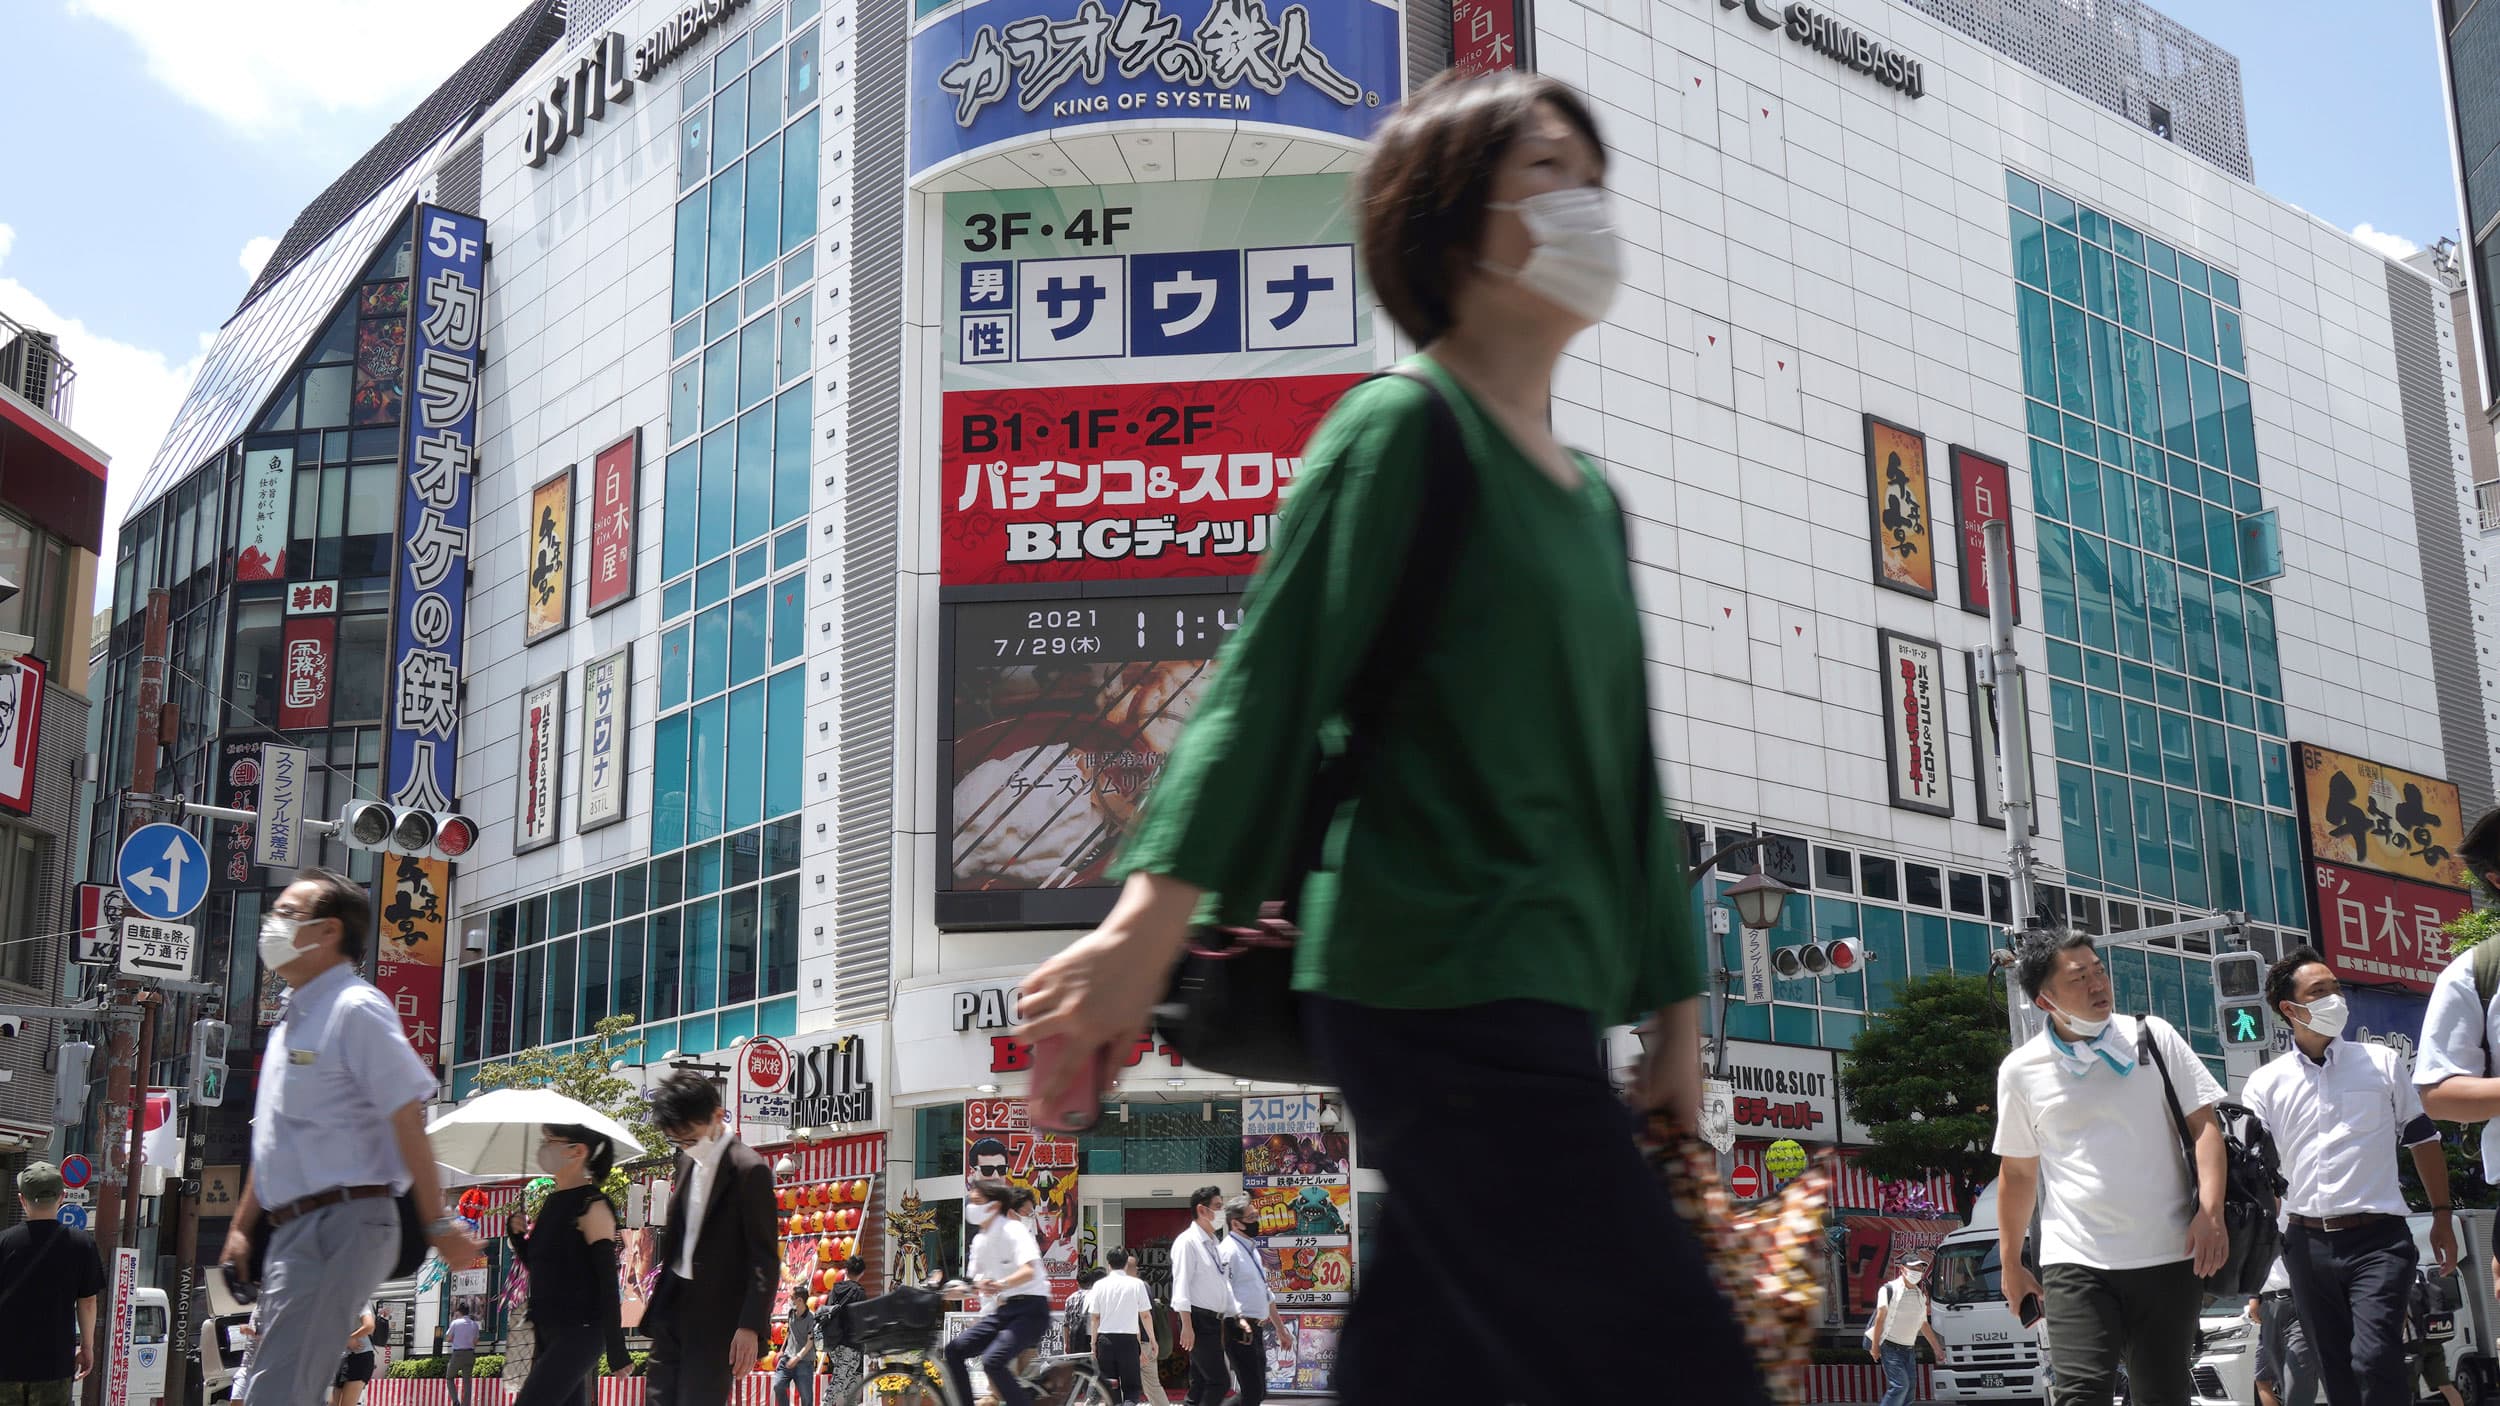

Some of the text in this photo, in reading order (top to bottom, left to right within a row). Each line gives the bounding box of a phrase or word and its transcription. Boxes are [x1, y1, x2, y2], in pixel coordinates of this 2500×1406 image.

[938, 0, 1363, 127] カラオケの鉄人
[1785, 2, 1925, 99] SHIMBASHI
[1053, 91, 1251, 117] KING OF SYSTEM
[428, 216, 477, 263] 5F
[963, 207, 1133, 252] 3F・4F
[969, 268, 1006, 356] 男性
[1036, 262, 1334, 342] サウナ
[601, 463, 629, 582] 白木屋
[393, 269, 481, 813] カラオケの鉄人
[292, 585, 332, 610] 羊肉
[1028, 610, 1098, 629] 2021
[593, 685, 612, 788] サウナ
[2304, 749, 2322, 771] 6F
[2316, 867, 2335, 889] 6F
[127, 924, 190, 945] 自転車を除く
[2336, 879, 2450, 966] 白木屋
[127, 943, 188, 961] 一方通行
[378, 965, 397, 977] 6F
[751, 1056, 782, 1076] 消火栓
[759, 1106, 789, 1117] ホテル
[968, 1101, 1009, 1130] 8.2
[1248, 1096, 1317, 1121] スロット
[190, 1134, 206, 1194] 柳通り
[1246, 1178, 1267, 1187] スロット
[176, 1266, 193, 1352] YANAGI-DORI
[1971, 1332, 2008, 1342] ISUZU
[2430, 1320, 2453, 1332] FILA
